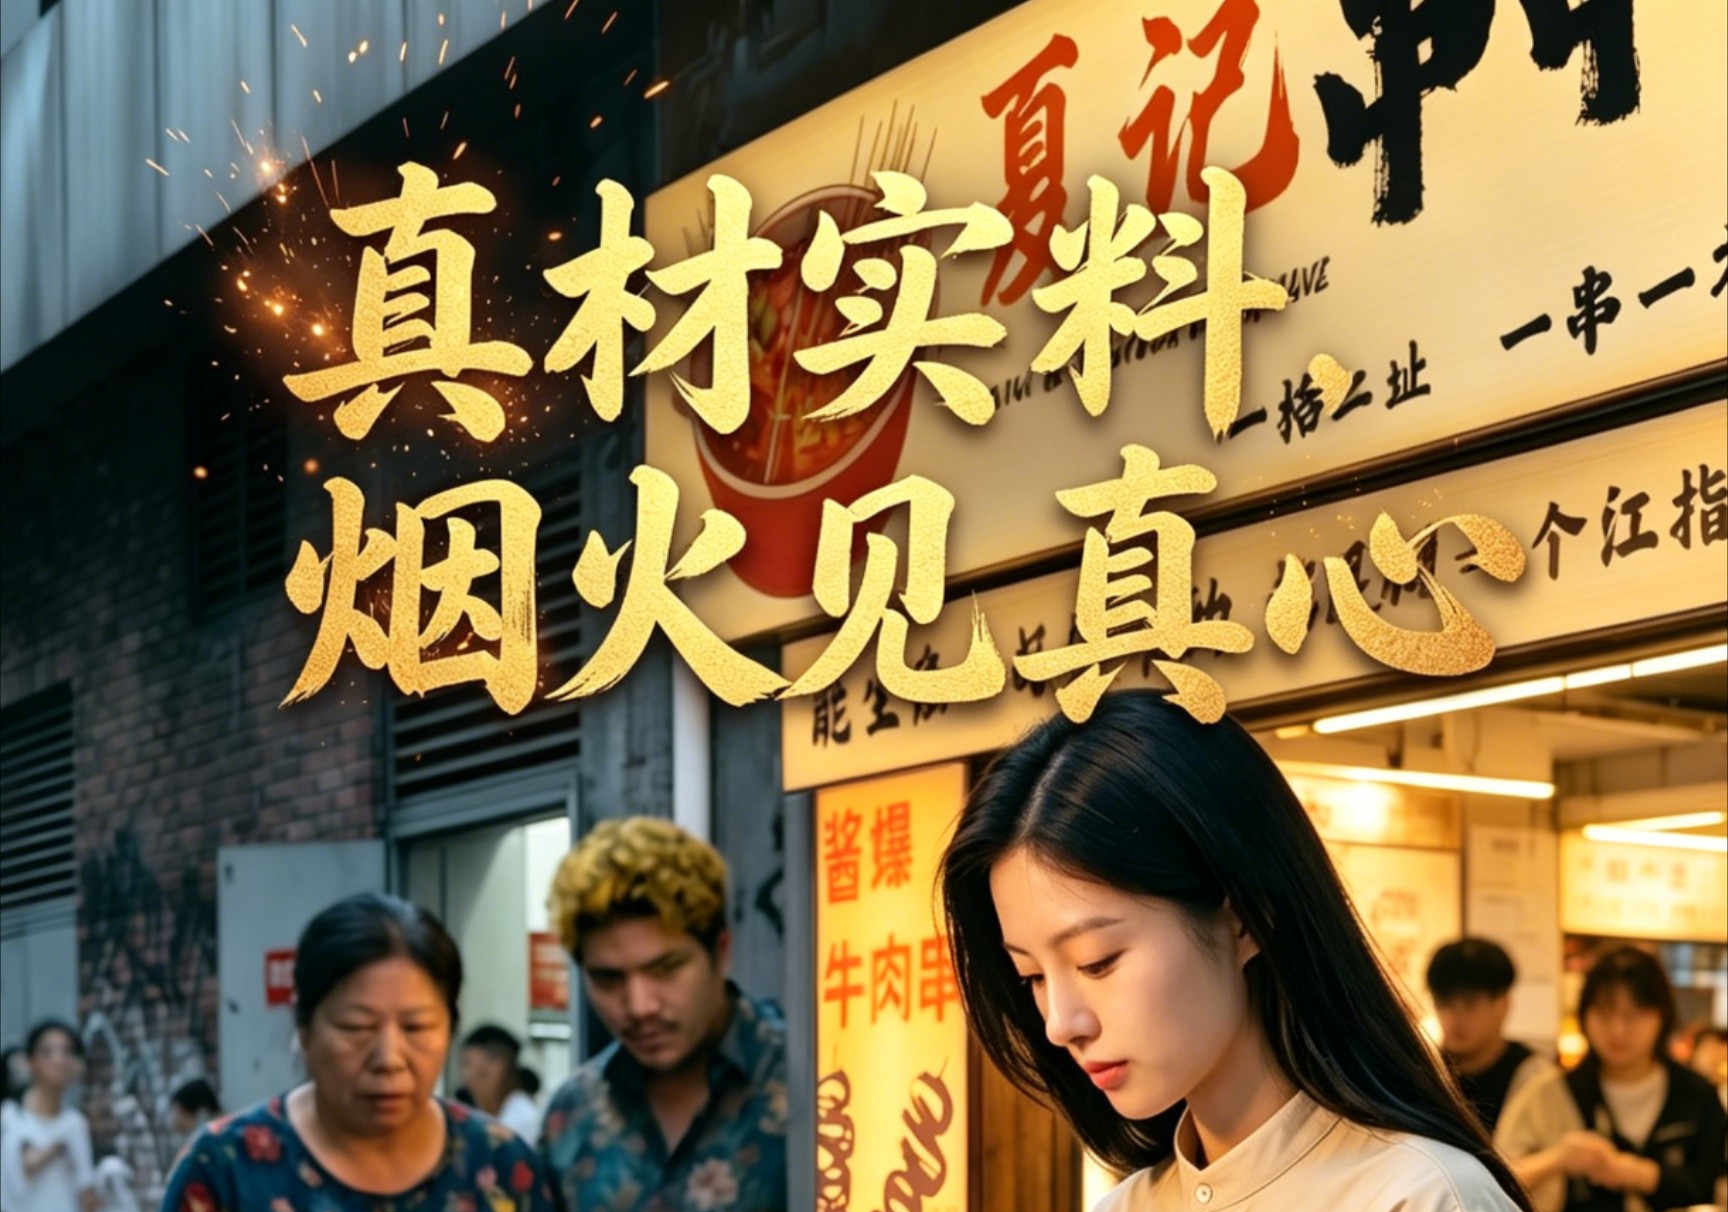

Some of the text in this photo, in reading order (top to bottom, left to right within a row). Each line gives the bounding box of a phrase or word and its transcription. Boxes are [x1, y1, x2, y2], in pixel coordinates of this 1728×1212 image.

[824, 800, 913, 906] 酱爆
[824, 933, 963, 1030] 牛肉串
